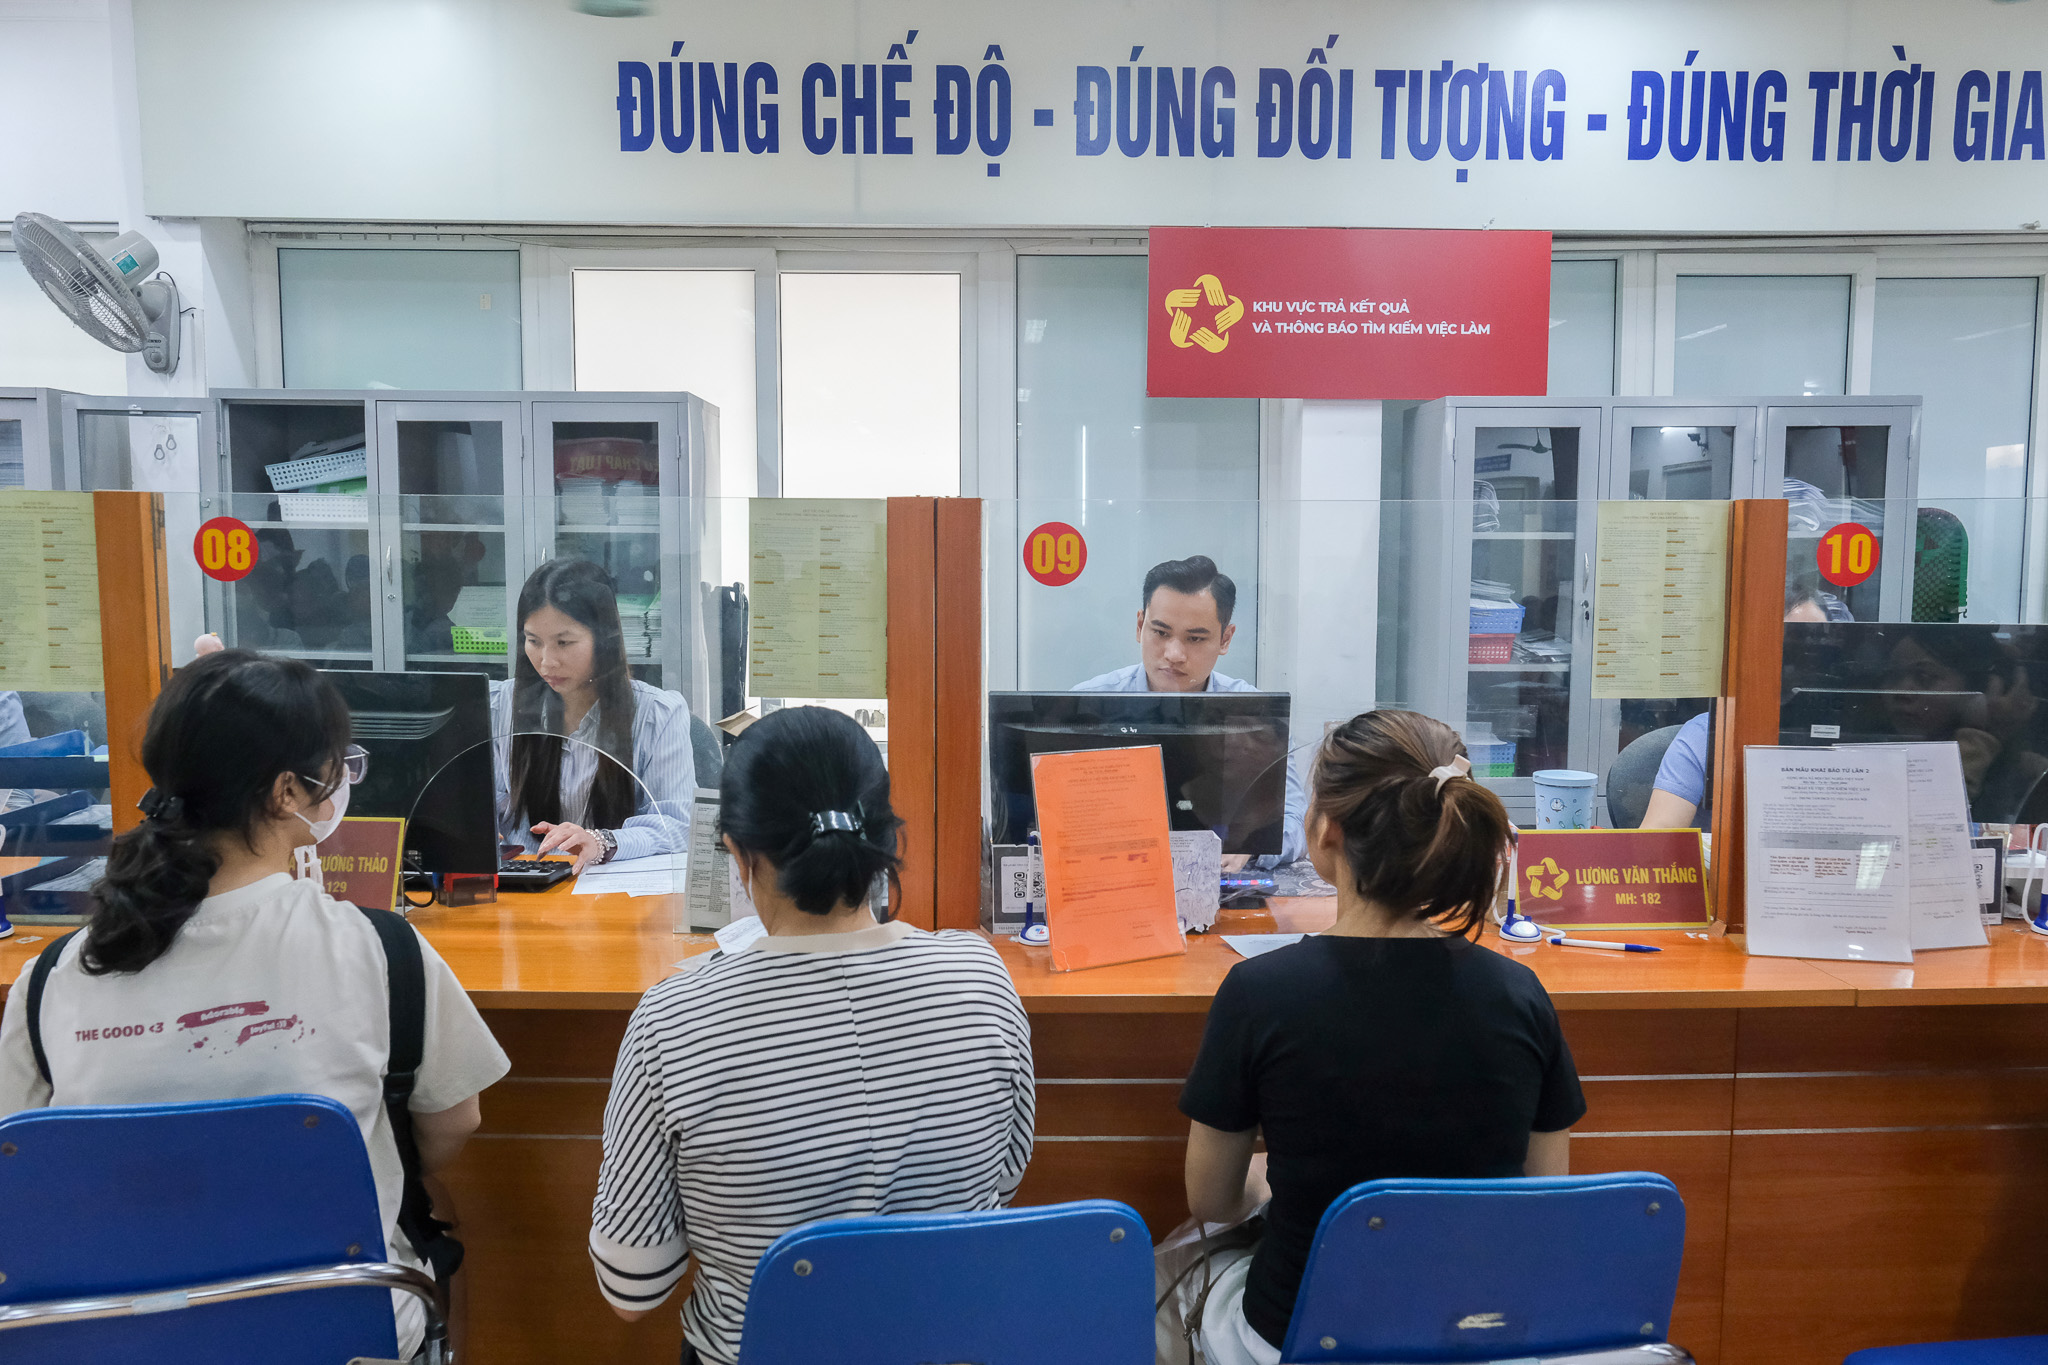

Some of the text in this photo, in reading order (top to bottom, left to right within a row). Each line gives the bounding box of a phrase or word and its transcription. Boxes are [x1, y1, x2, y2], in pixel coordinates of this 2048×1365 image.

[616, 30, 2046, 183] ĐÚNG CHẾ ĐỘ - ĐÚNG ĐỐI TƯỢNG - ĐÚNG THỜI GIA
[1252, 298, 1410, 315] KHU VỰC TRẢ KẾT QUẢ
[1252, 319, 1490, 337] VÀ THÔNG BÁO TÌM KIẾM VIỆC LÀM
[202, 528, 251, 571] 08
[1032, 533, 1080, 574] 09
[1826, 533, 1872, 574] 10
[358, 852, 389, 873] THẢO
[1575, 862, 1697, 885] LƯƠNG VĂN THẮNG
[327, 881, 348, 893] 129
[1615, 893, 1661, 904] MH: 182
[74, 1022, 164, 1042] THE GOOD <3
